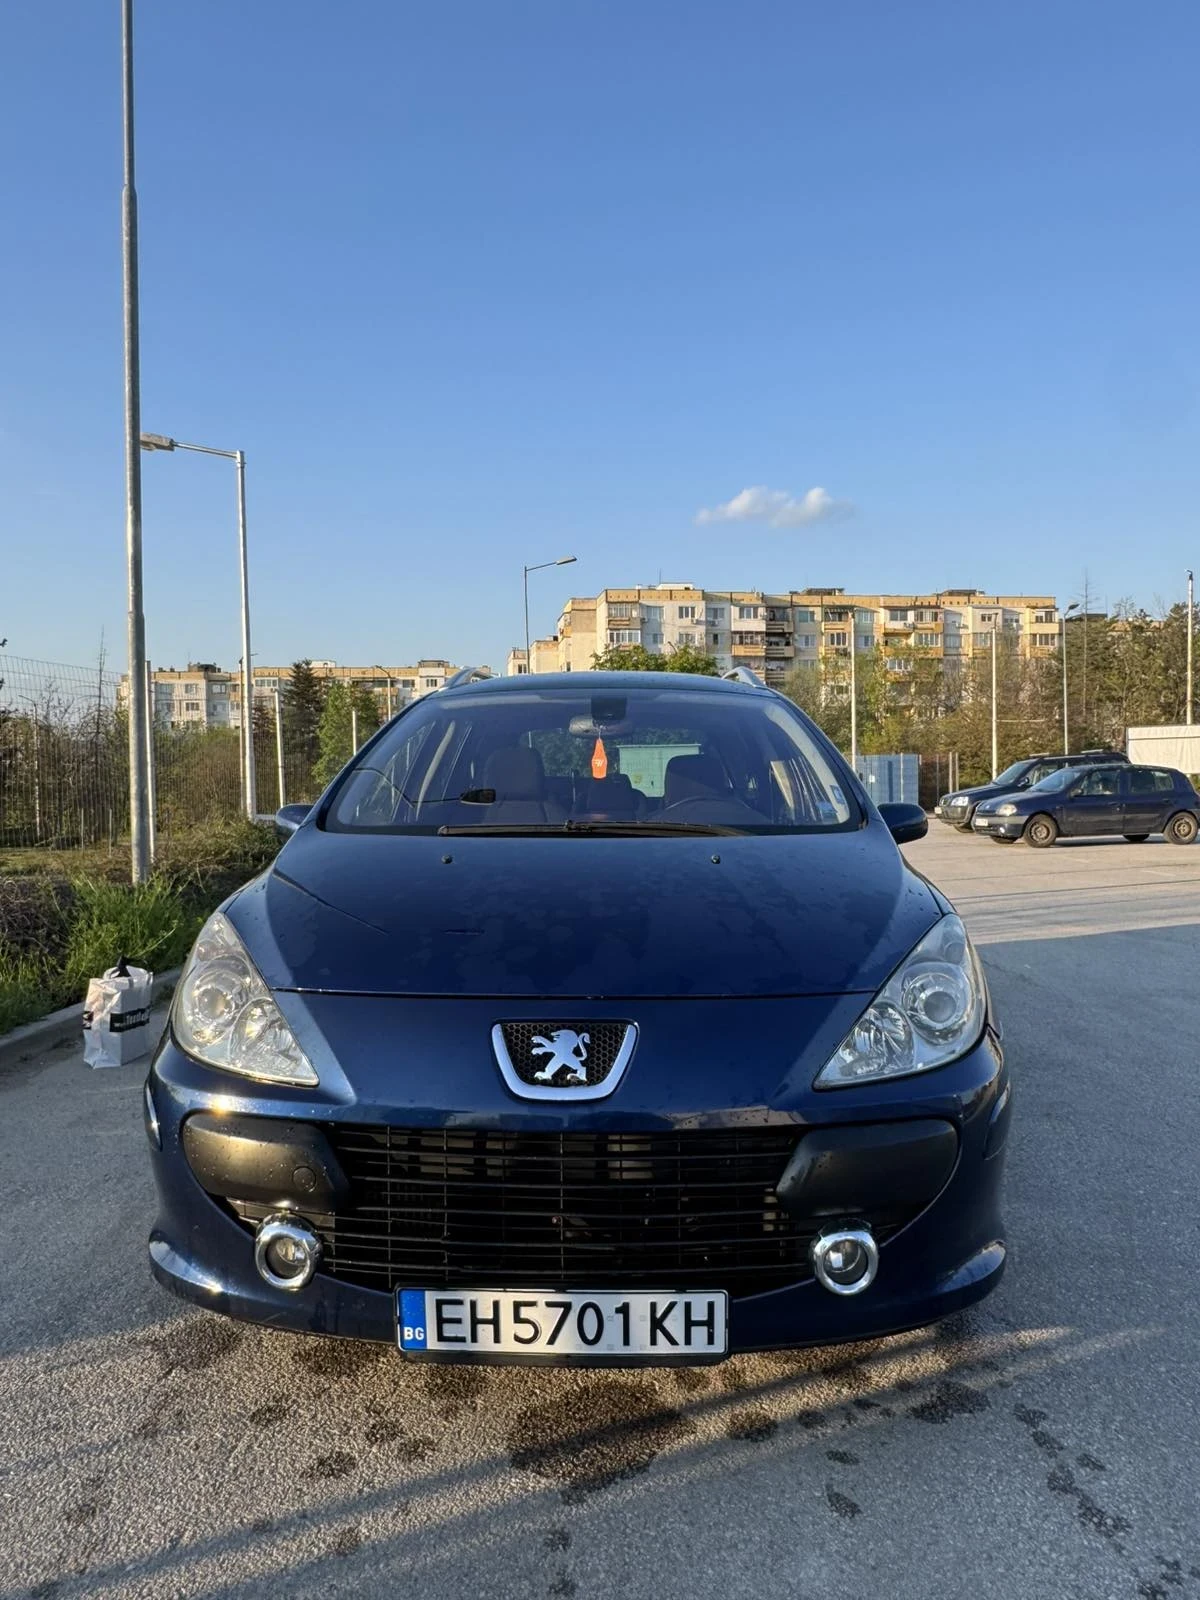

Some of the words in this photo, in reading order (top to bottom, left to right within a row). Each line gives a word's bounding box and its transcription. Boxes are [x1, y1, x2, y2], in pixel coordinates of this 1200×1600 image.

[403, 1326, 425, 1341] BG
[434, 1298, 501, 1344] EH
[513, 1300, 630, 1346] 5701
[649, 1301, 715, 1346] KH
